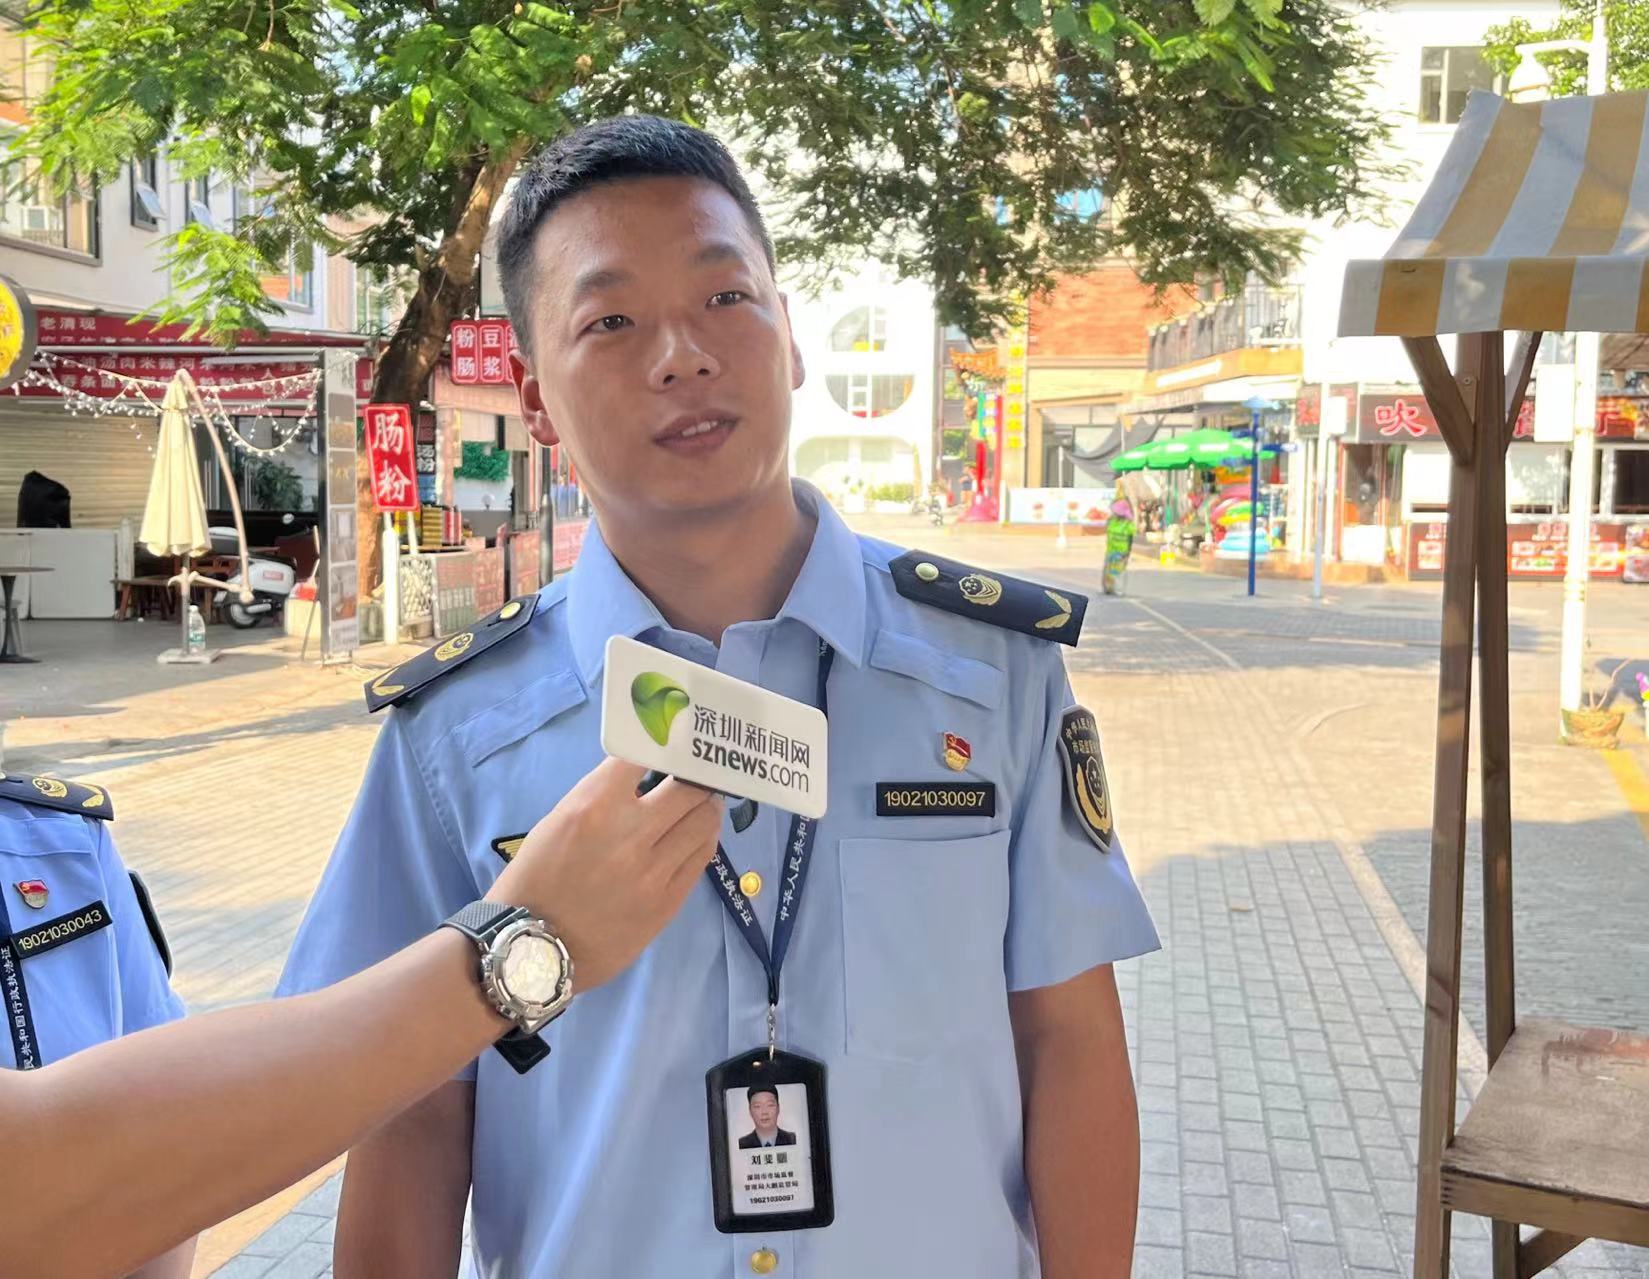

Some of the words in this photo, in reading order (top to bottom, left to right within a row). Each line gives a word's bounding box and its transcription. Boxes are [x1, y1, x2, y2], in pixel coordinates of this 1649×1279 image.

[371, 411, 412, 502] 肠粉
[693, 703, 811, 769] 深圳新闻网
[691, 737, 810, 793] sznews.com
[884, 790, 987, 808] 19021030097
[18, 909, 103, 950] 19021030043
